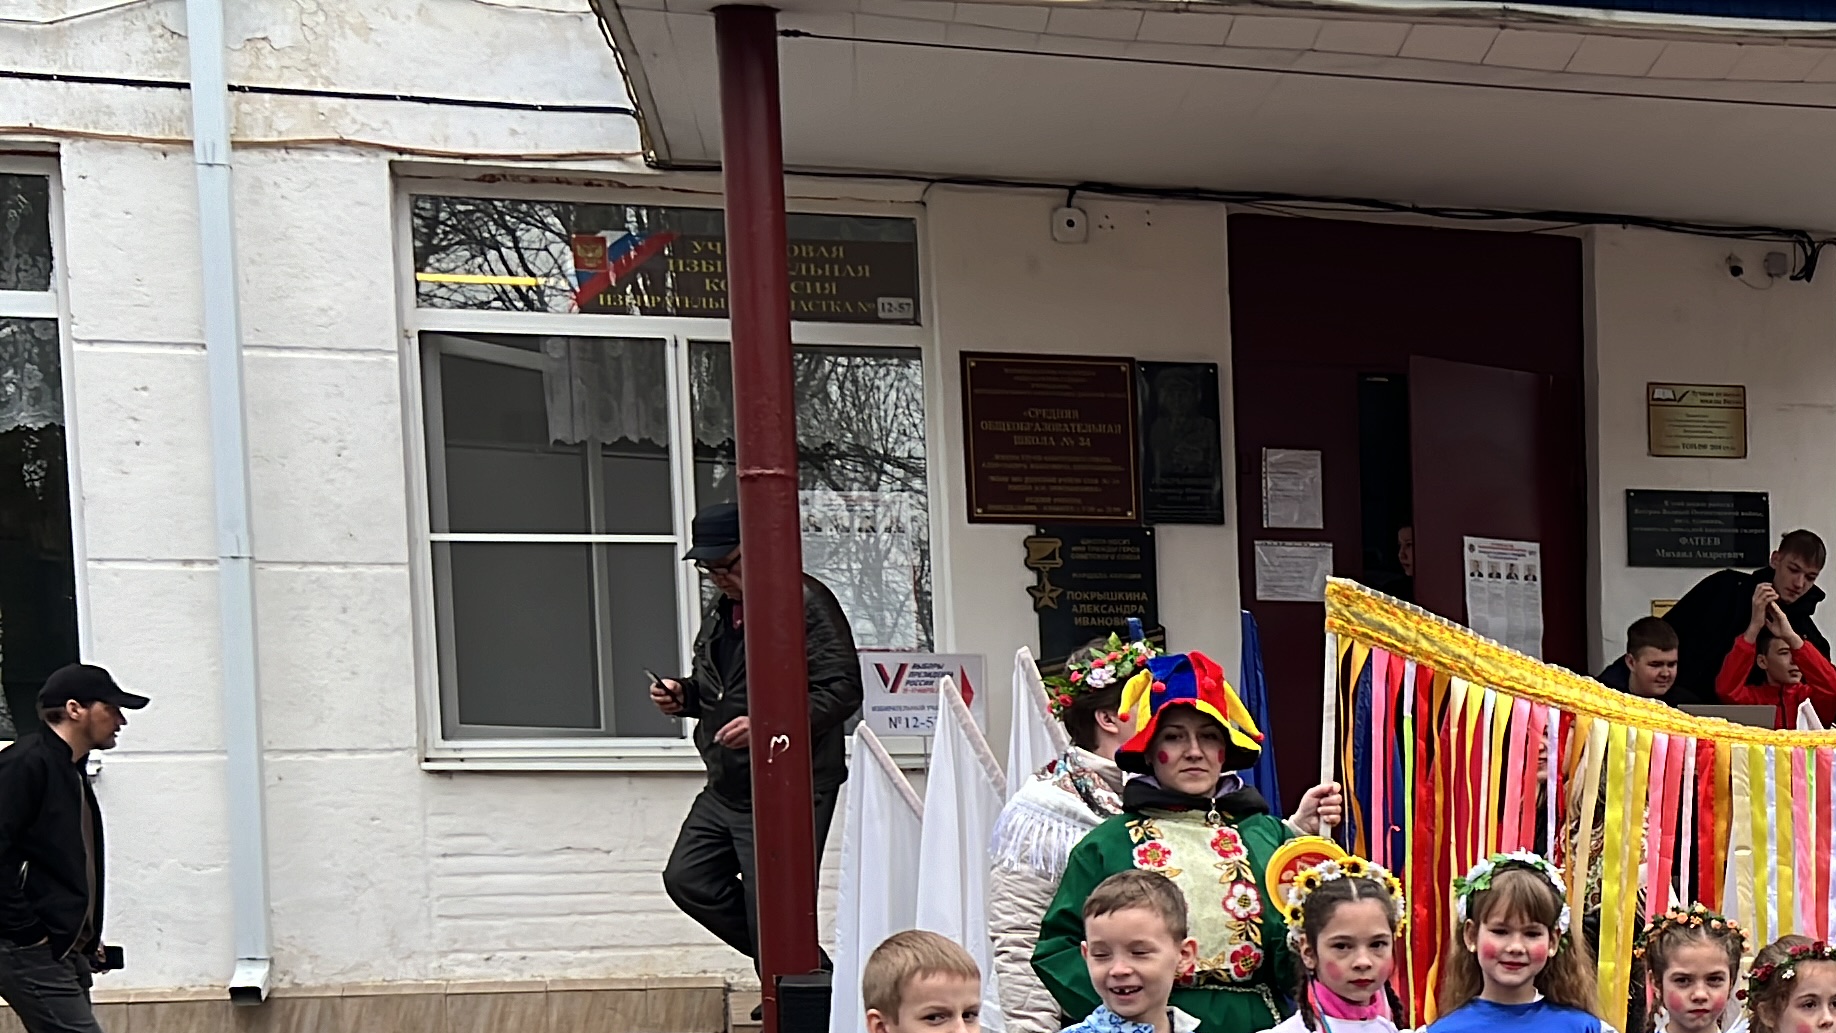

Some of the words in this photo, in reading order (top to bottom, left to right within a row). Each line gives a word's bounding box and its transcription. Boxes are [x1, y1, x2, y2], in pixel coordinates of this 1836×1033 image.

[1013, 435, 1055, 446] ШКОЛА
[1679, 537, 1721, 546] ФАТЕЕВ
[1656, 548, 1693, 558] Михаил
[1694, 550, 1745, 560] Андреевич
[1066, 591, 1149, 601] ПОКРЫШКИНА
[1072, 604, 1146, 615] АЛЕКСАНДРА
[1074, 616, 1128, 626] ИВАНОВИ
